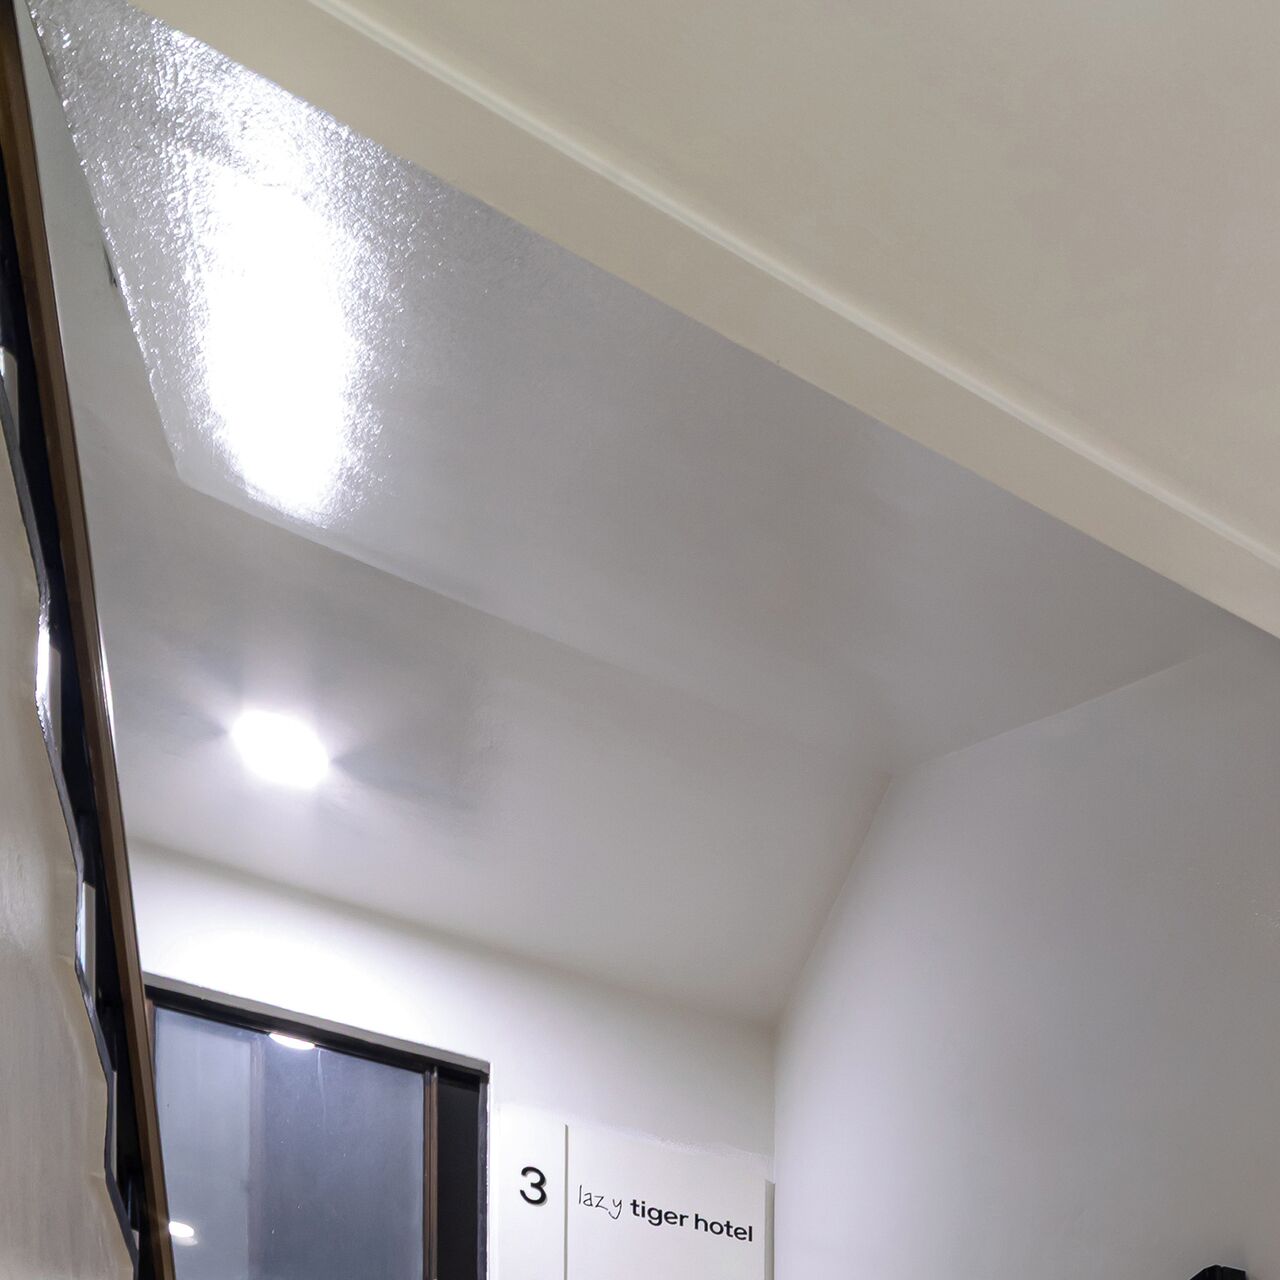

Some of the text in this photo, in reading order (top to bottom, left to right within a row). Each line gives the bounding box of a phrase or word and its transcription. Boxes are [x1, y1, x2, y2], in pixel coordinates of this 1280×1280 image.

[519, 1166, 547, 1205] 3
[578, 1184, 753, 1242] lazy tiger hotel
